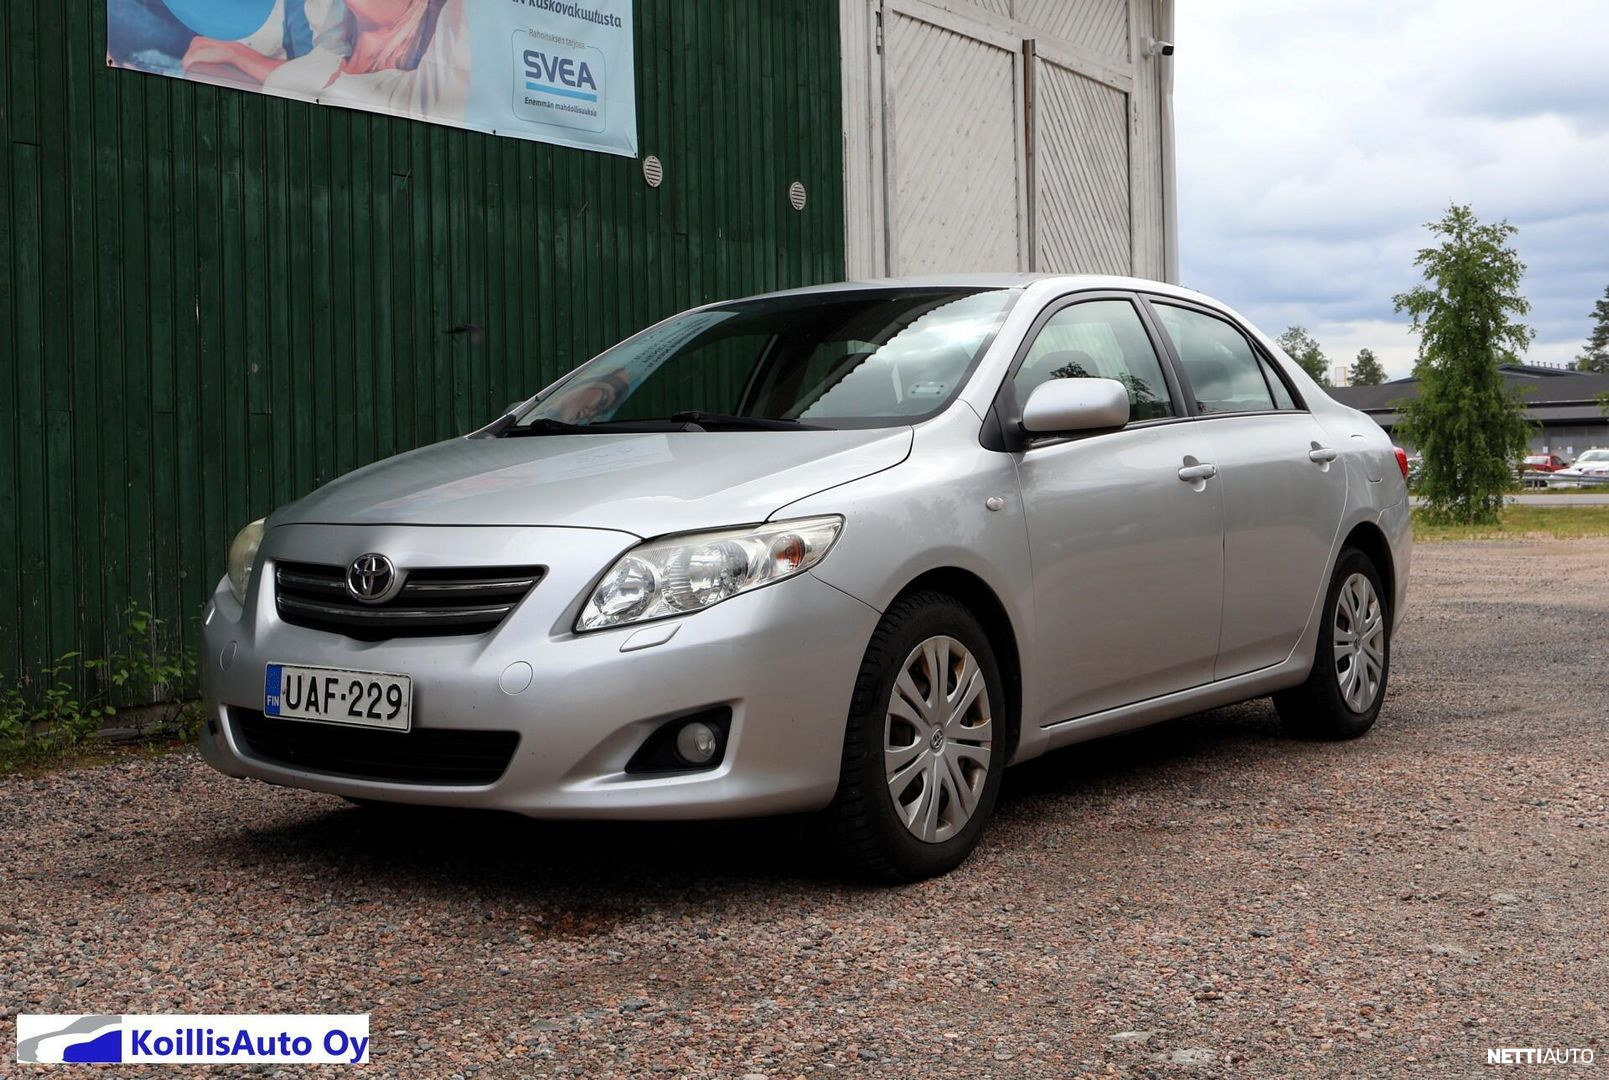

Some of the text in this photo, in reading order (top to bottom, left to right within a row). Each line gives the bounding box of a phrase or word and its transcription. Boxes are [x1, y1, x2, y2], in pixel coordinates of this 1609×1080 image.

[528, 28, 565, 44] Rahoituksen
[523, 49, 597, 90] SVEA
[524, 96, 597, 117] Enemmän mahdollisuuksia
[267, 694, 280, 706] FIN
[285, 675, 403, 720] UAF-229
